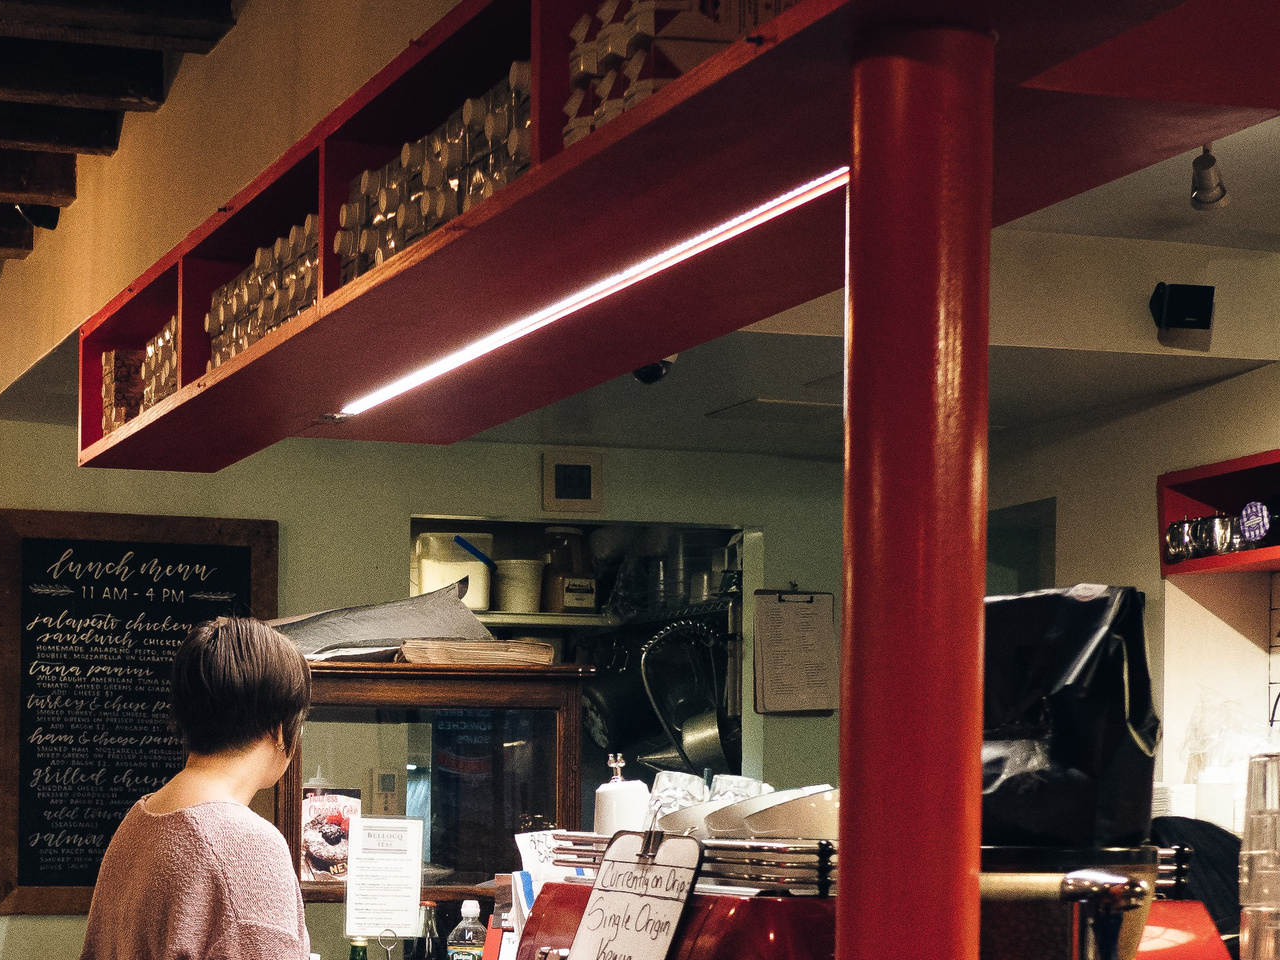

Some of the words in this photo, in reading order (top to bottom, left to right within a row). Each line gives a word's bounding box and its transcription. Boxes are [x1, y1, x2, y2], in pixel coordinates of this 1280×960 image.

[46, 548, 135, 582] lunch
[138, 558, 217, 582] menu
[82, 585, 94, 599] 11
[102, 586, 128, 600] AM
[145, 587, 155, 602] 4
[163, 588, 185, 603] PM
[125, 612, 193, 633] chicken
[36, 628, 138, 648] sandwich
[28, 660, 82, 677] tuna
[86, 665, 154, 677] panini
[26, 693, 89, 711] turkey
[104, 695, 151, 712] cheese
[28, 727, 74, 746] ham
[92, 731, 139, 746] cheese
[29, 766, 107, 788] grilled
[113, 768, 168, 788] cheese
[43, 806, 80, 820] add
[28, 829, 104, 848] salmon
[367, 832, 403, 841] BELLOCQ
[600, 861, 650, 896] Currently
[651, 873, 664, 889] on
[586, 896, 631, 941] Single
[634, 903, 671, 940] Origin
